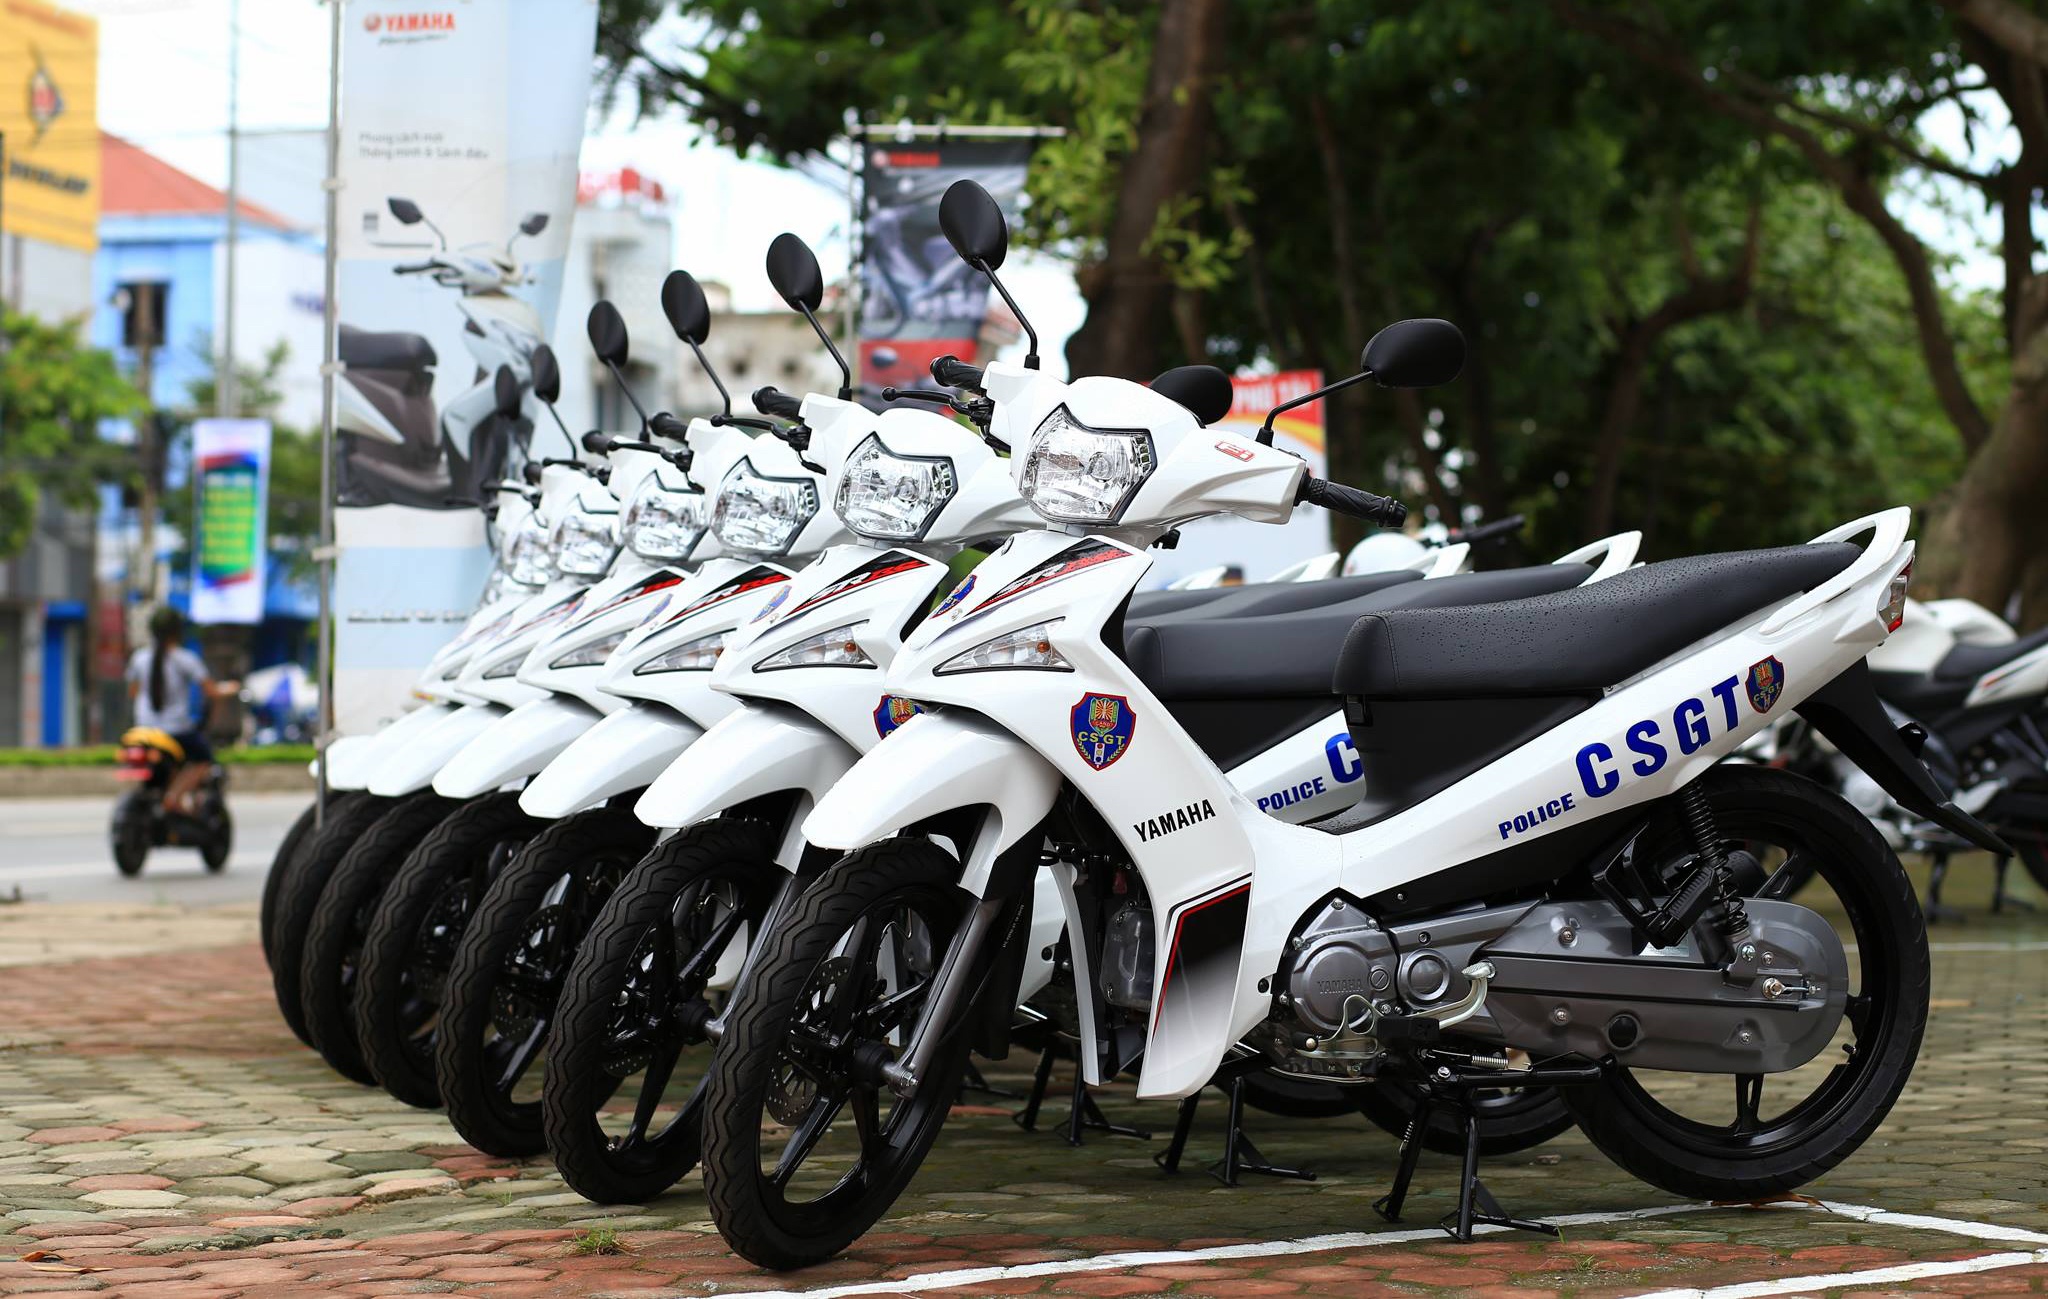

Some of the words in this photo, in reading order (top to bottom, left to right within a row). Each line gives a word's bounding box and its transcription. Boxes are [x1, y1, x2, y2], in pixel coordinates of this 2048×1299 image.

[386, 13, 456, 31] YAMAHA
[1078, 731, 1126, 746] CSGT
[1575, 674, 1740, 799] CSGT
[1257, 776, 1327, 814] POLICE
[1133, 798, 1217, 843] YAMAHA
[1498, 792, 1576, 840] POLICE
